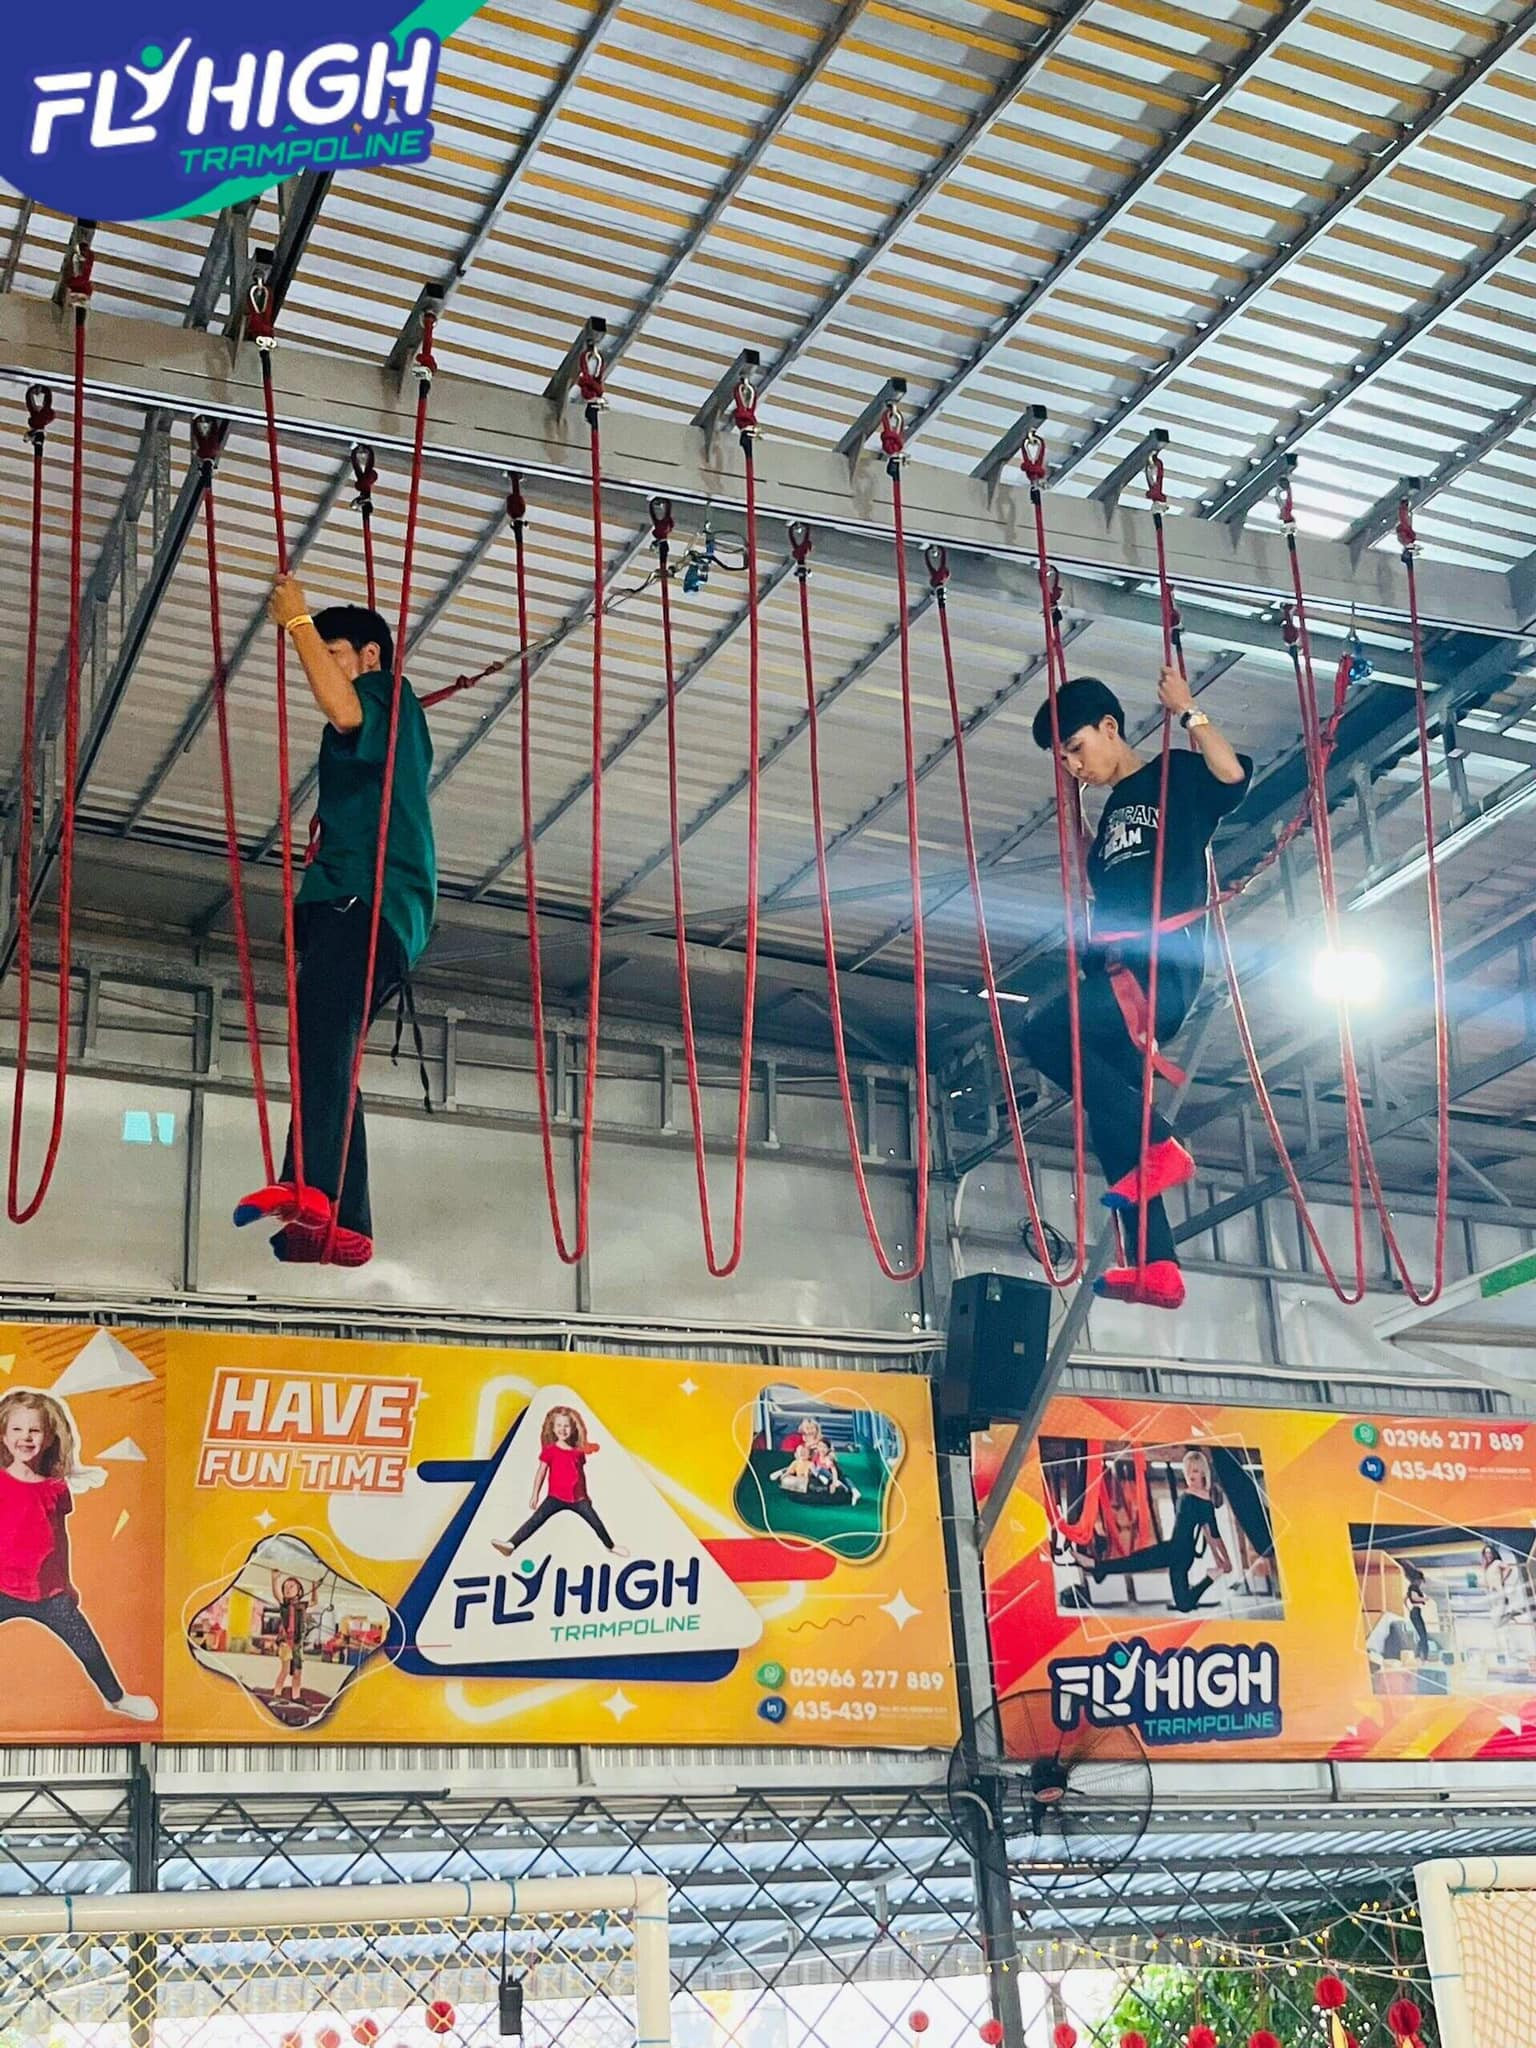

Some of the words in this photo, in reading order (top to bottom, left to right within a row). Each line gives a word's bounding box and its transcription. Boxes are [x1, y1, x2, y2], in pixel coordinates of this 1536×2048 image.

[216, 1376, 410, 1438] HAVE
[1382, 1428, 1444, 1449] 02966
[1448, 1431, 1482, 1450] 277
[1488, 1432, 1524, 1452] 889
[203, 1450, 288, 1484] FUN
[300, 1453, 404, 1488] TIME
[1390, 1460, 1467, 1482] 435-439
[550, 1614, 701, 1643] TRAMPOLINE
[789, 1668, 856, 1688] 02966
[862, 1670, 899, 1688] 277
[906, 1672, 945, 1691] 889
[792, 1701, 877, 1721] 435-439
[1144, 1711, 1275, 1737] TRAMPOLINE
